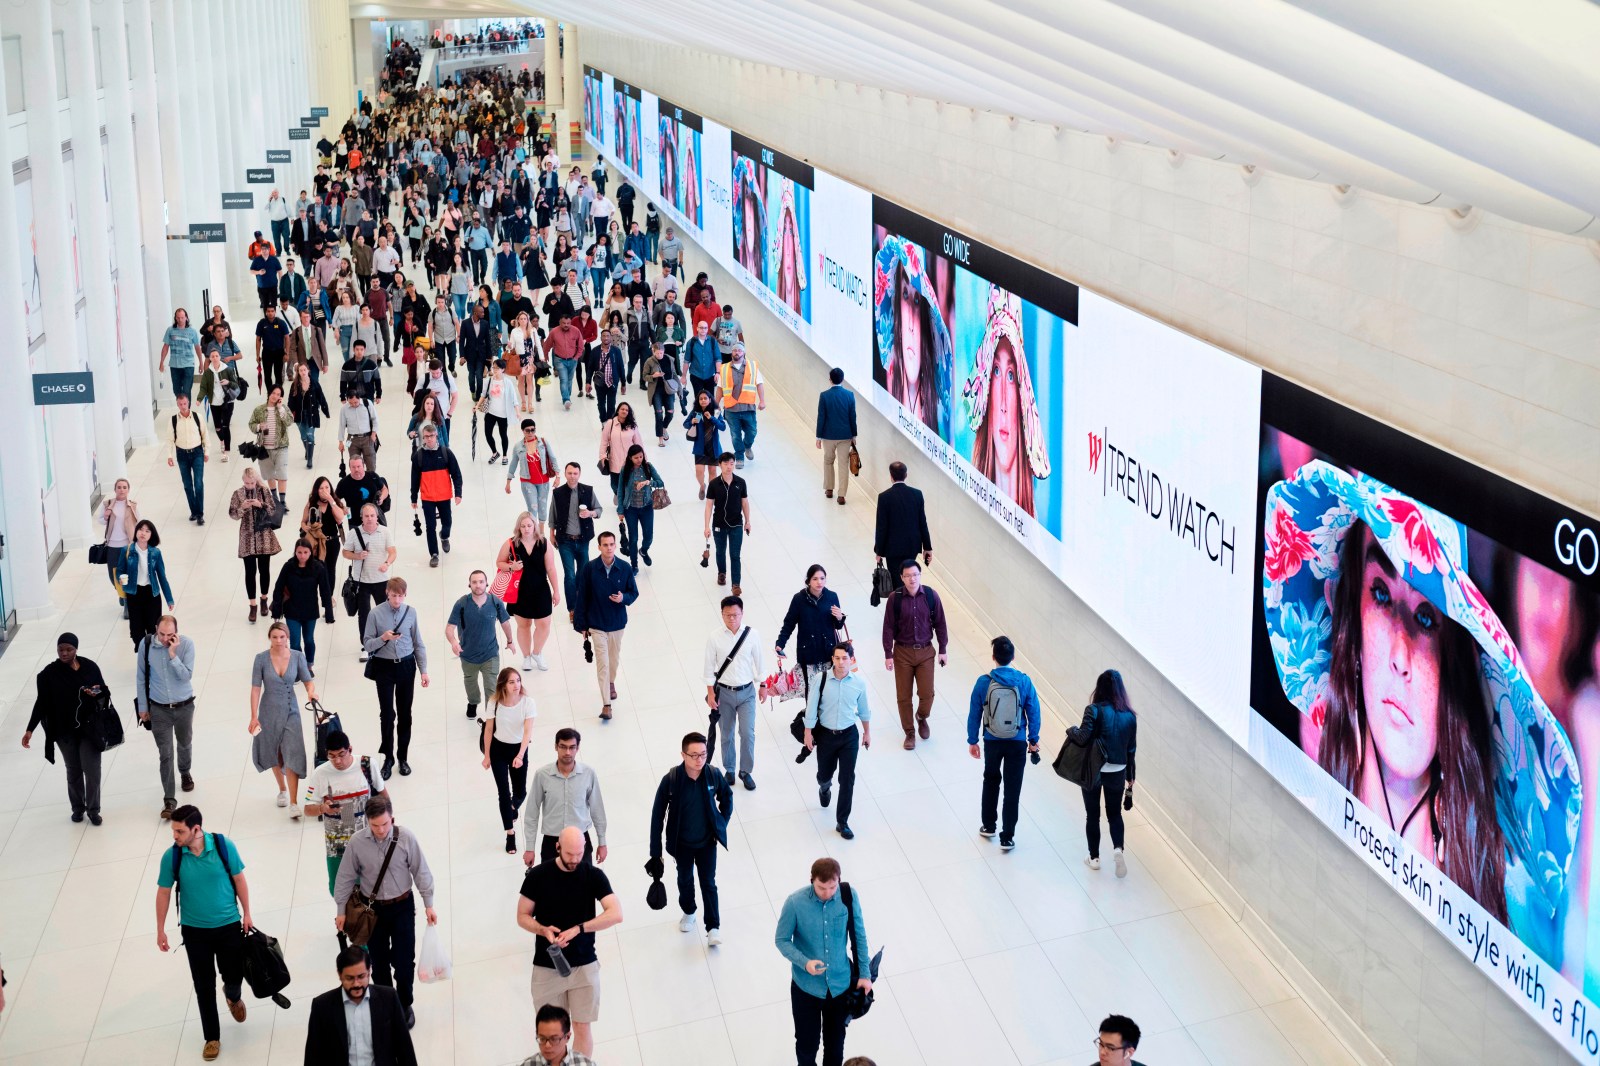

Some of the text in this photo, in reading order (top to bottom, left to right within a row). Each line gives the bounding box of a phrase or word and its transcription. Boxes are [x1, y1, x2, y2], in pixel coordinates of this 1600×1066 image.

[943, 232, 970, 265] GO WIDE
[825, 257, 845, 293] TREND
[845, 270, 867, 310] WATCH
[41, 384, 75, 393] CHASE
[898, 405, 913, 436] Protect
[927, 436, 938, 461] style
[969, 472, 988, 504] tropical
[989, 490, 1002, 515] print
[1003, 506, 1013, 526] sun
[1108, 443, 1163, 519] TREND
[1167, 483, 1235, 575] WATCH
[1554, 518, 1599, 575] GO
[1344, 796, 1599, 1056] Protect skin in style with a flo
